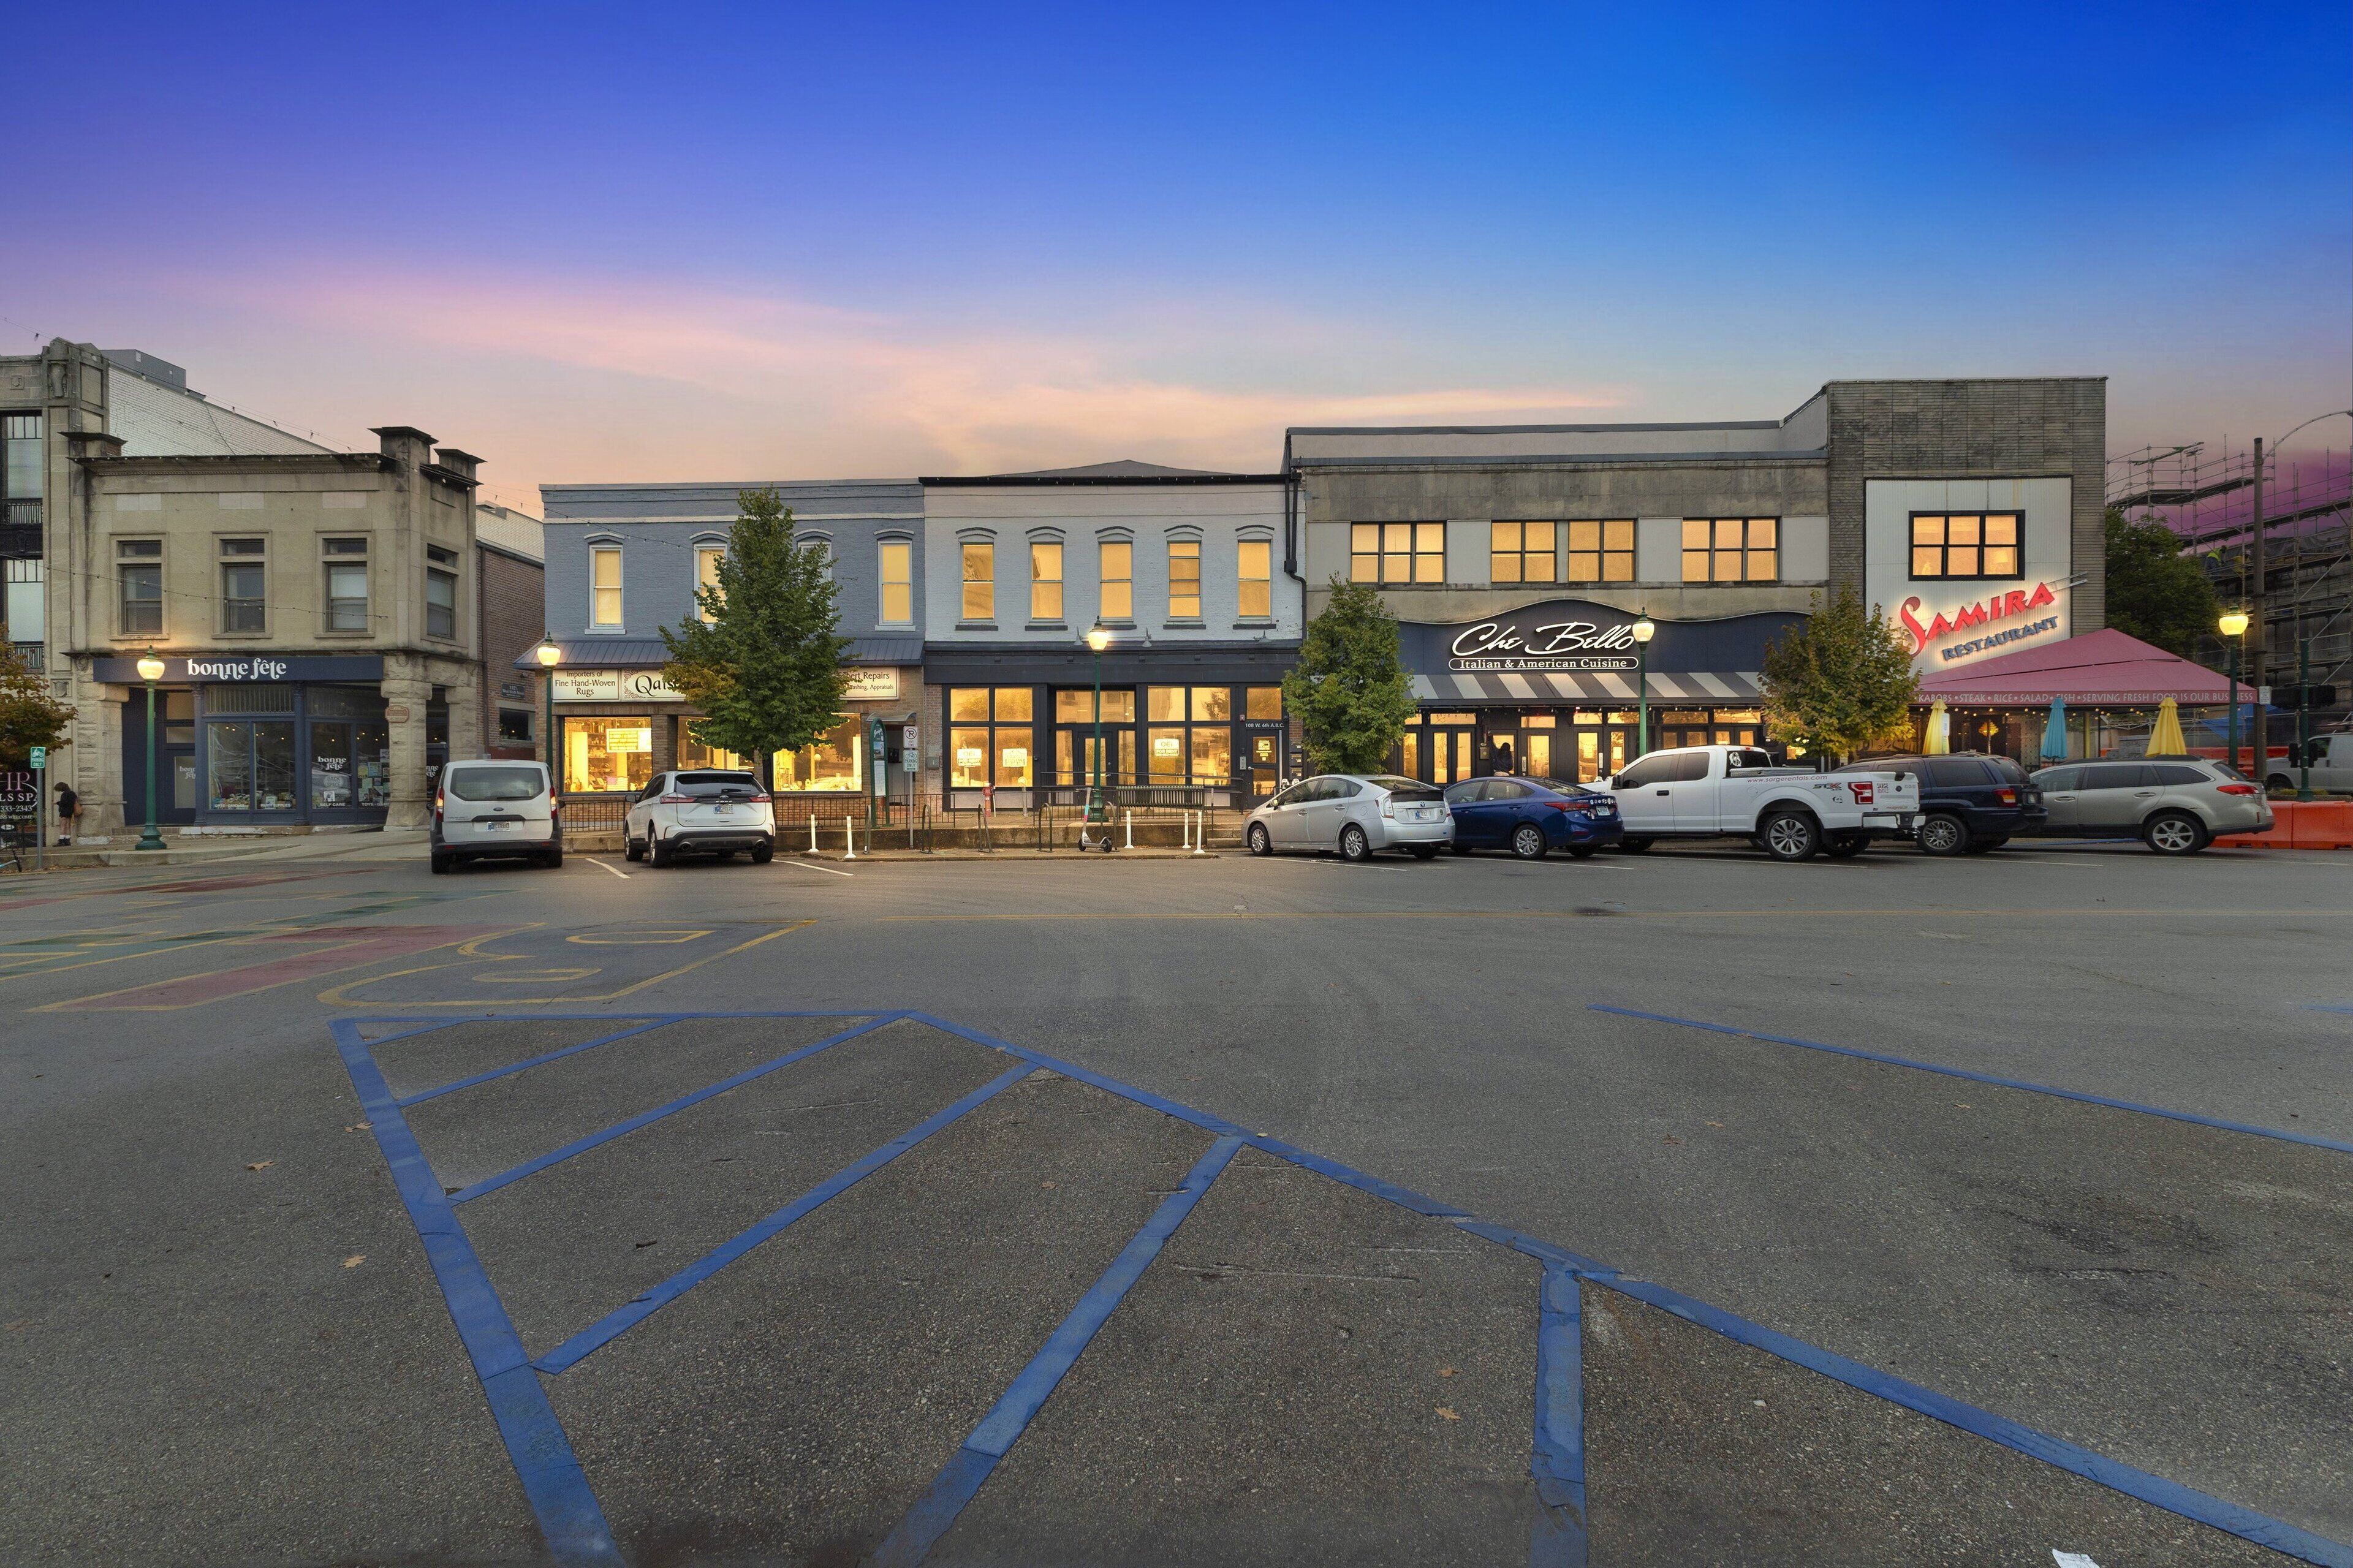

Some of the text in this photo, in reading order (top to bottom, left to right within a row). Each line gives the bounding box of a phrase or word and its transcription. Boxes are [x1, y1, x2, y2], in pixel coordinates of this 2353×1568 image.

[1901, 582, 2055, 657] SAMIRA
[1452, 621, 1634, 656] Che Bello
[1942, 616, 2058, 661] RESTAURANT
[187, 657, 287, 680] bonne fête
[1460, 659, 1627, 668] Italian & American Cuisine
[863, 672, 890, 681] Repairs
[576, 687, 594, 697] Rugs
[1959, 694, 1986, 702] STEAK
[1993, 694, 2012, 702] RICE
[2020, 694, 2048, 702] SALAD
[2082, 693, 2120, 702] SERVING
[2123, 693, 2149, 702] FRESH
[2180, 692, 2188, 701] IS
[2190, 692, 2210, 702] OUR
